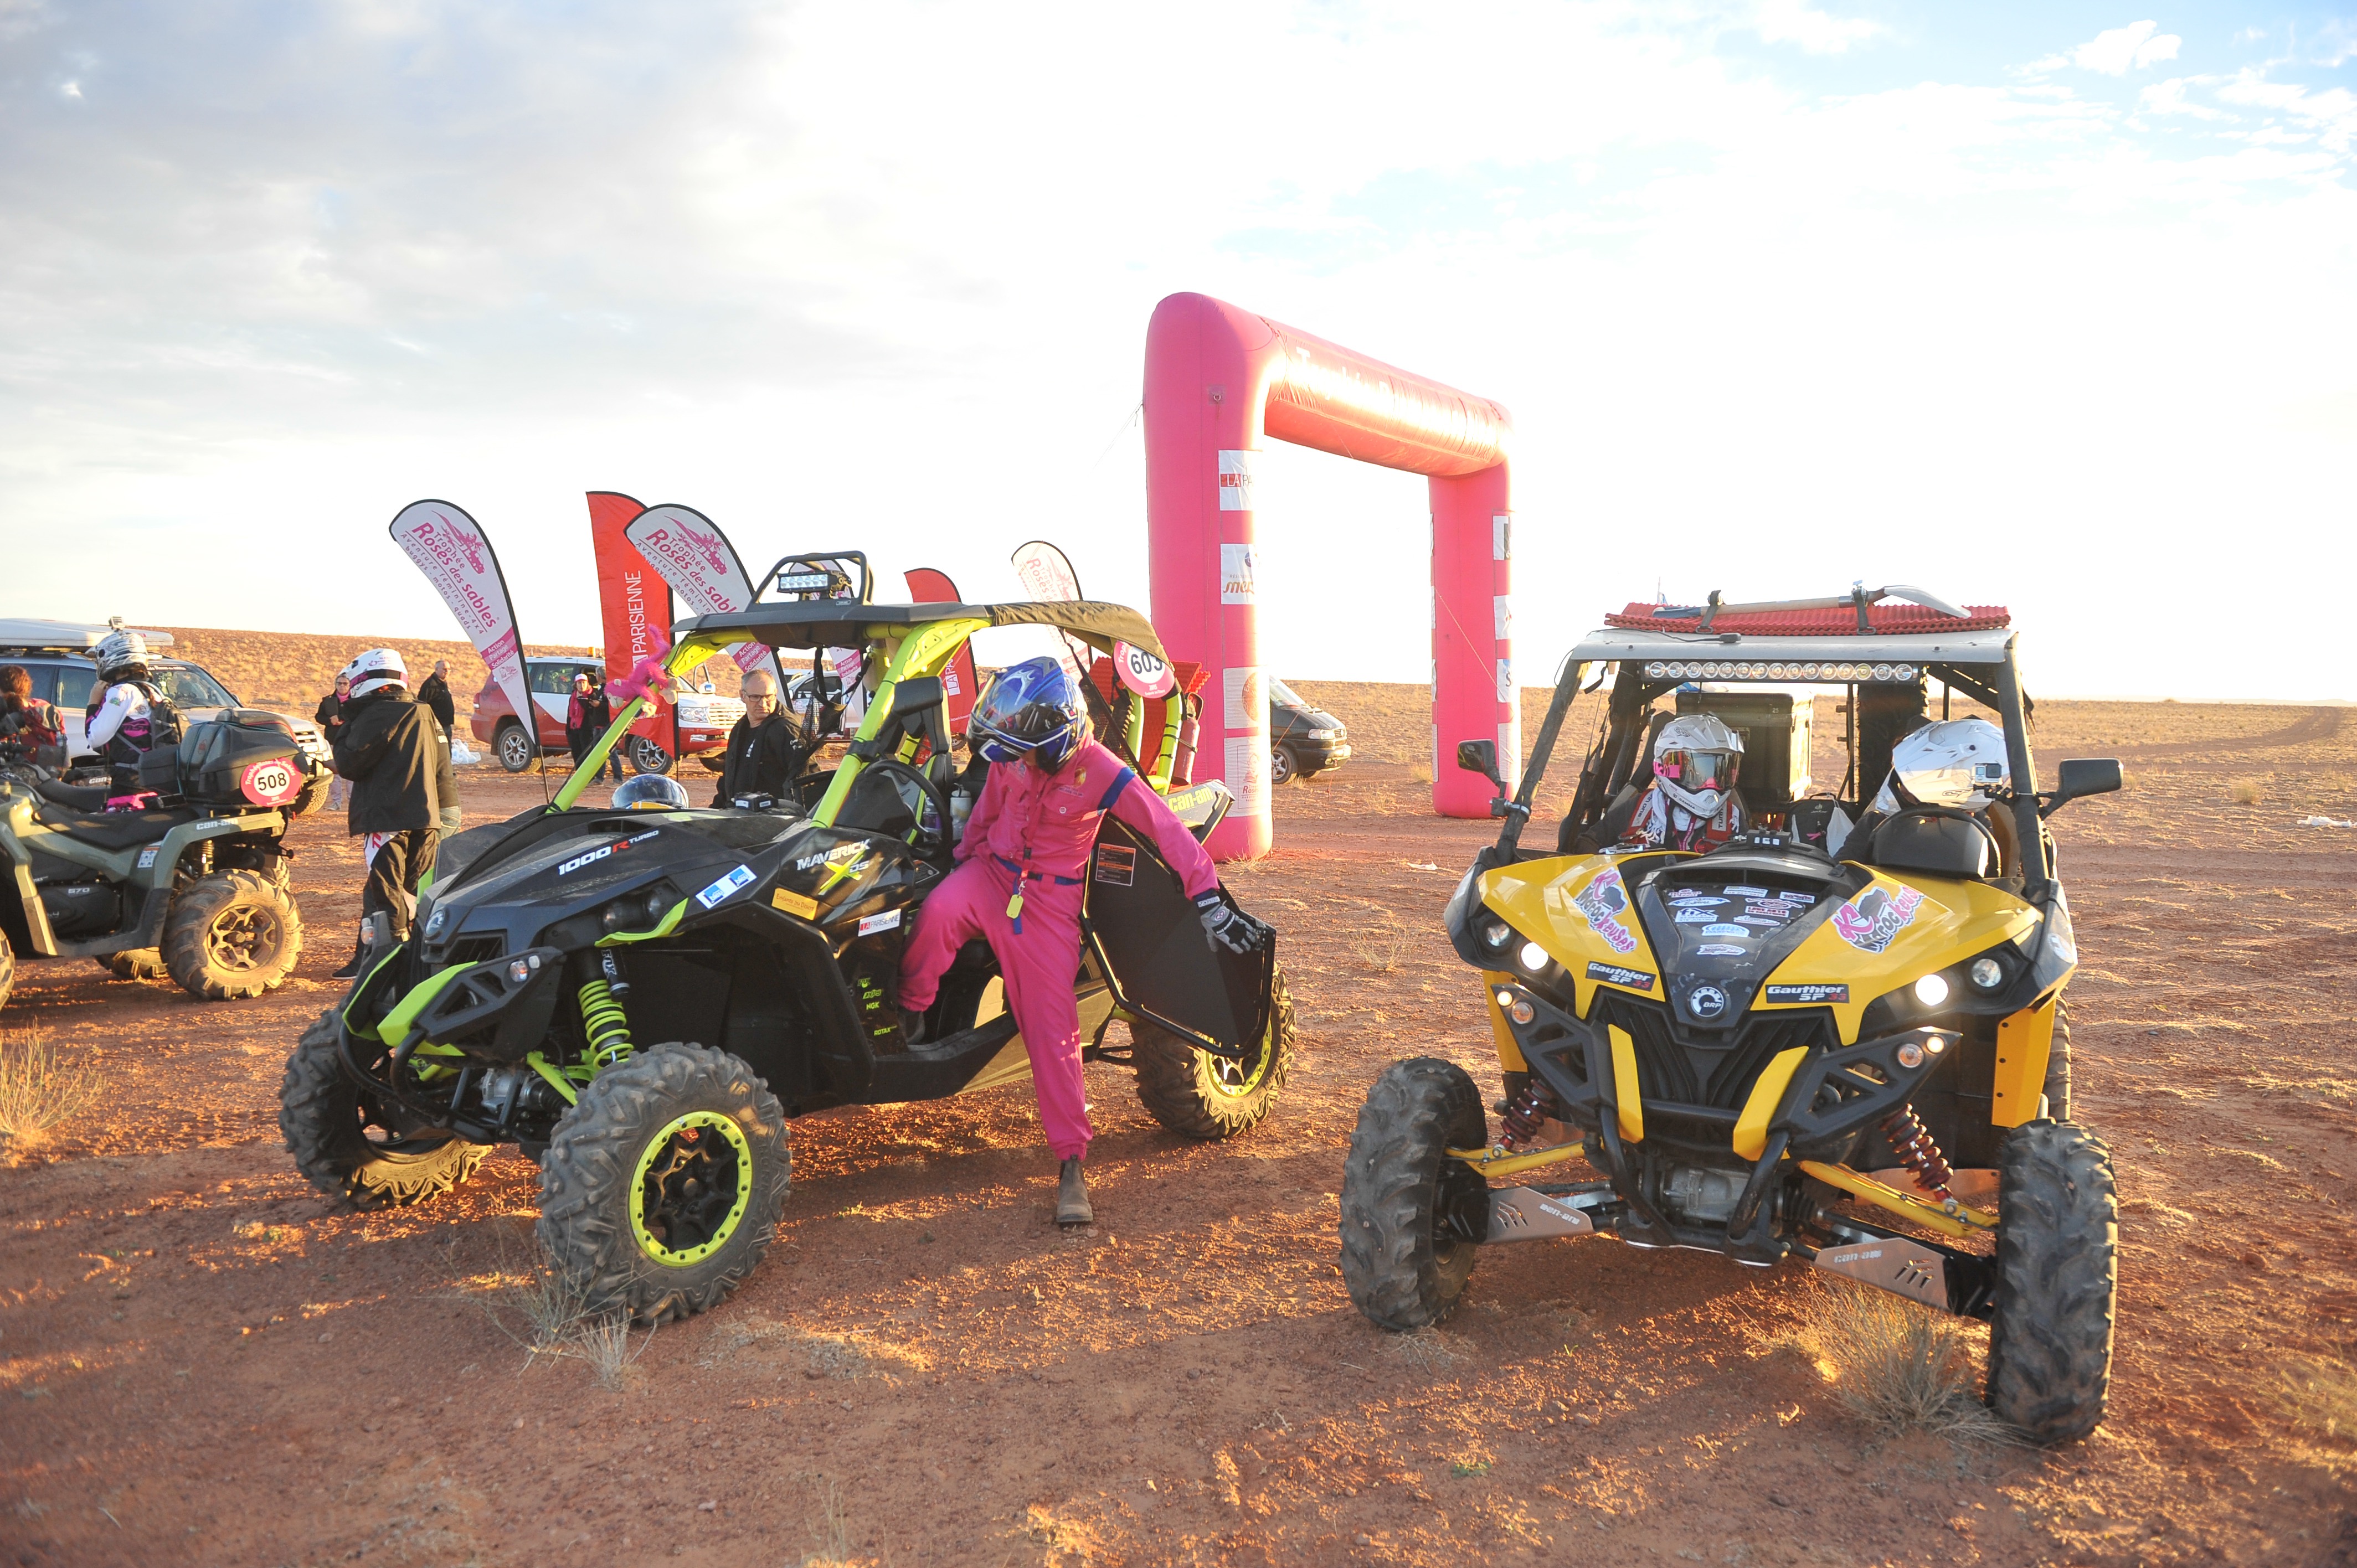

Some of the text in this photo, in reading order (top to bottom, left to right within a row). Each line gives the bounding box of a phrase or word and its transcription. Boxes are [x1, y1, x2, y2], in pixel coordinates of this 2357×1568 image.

[1227, 474, 1241, 487] LA
[400, 534, 438, 570] Aventure
[434, 532, 465, 569] Trophée
[636, 542, 677, 576] Aventure
[646, 528, 692, 570] Roses
[689, 571, 706, 587] des
[669, 537, 706, 572] Trophée
[412, 523, 496, 627] Roses des sables
[1026, 558, 1049, 594] Roses
[405, 546, 471, 630] buggys motos quads
[674, 584, 694, 605] motos
[625, 570, 649, 653] PARISIENNE
[488, 639, 505, 654] Action
[488, 644, 509, 661] Partage
[739, 642, 755, 658] Action
[741, 646, 760, 664] Partage
[491, 649, 514, 669] Solidarité
[744, 650, 767, 673] Solidarité
[1130, 652, 1163, 674] 603
[946, 675, 959, 689] LA
[257, 772, 287, 791] 508
[1168, 787, 1214, 813] can-am
[196, 818, 239, 831] can-am
[629, 830, 659, 844] TURBO
[796, 838, 871, 870] MAVERICK
[871, 914, 899, 928] PARISIENNE
[1588, 962, 1651, 981] Gauthier
[1767, 986, 1845, 995] Gauthier
[866, 1002, 879, 1010] NGK
[1540, 1203, 1580, 1225] can-am
